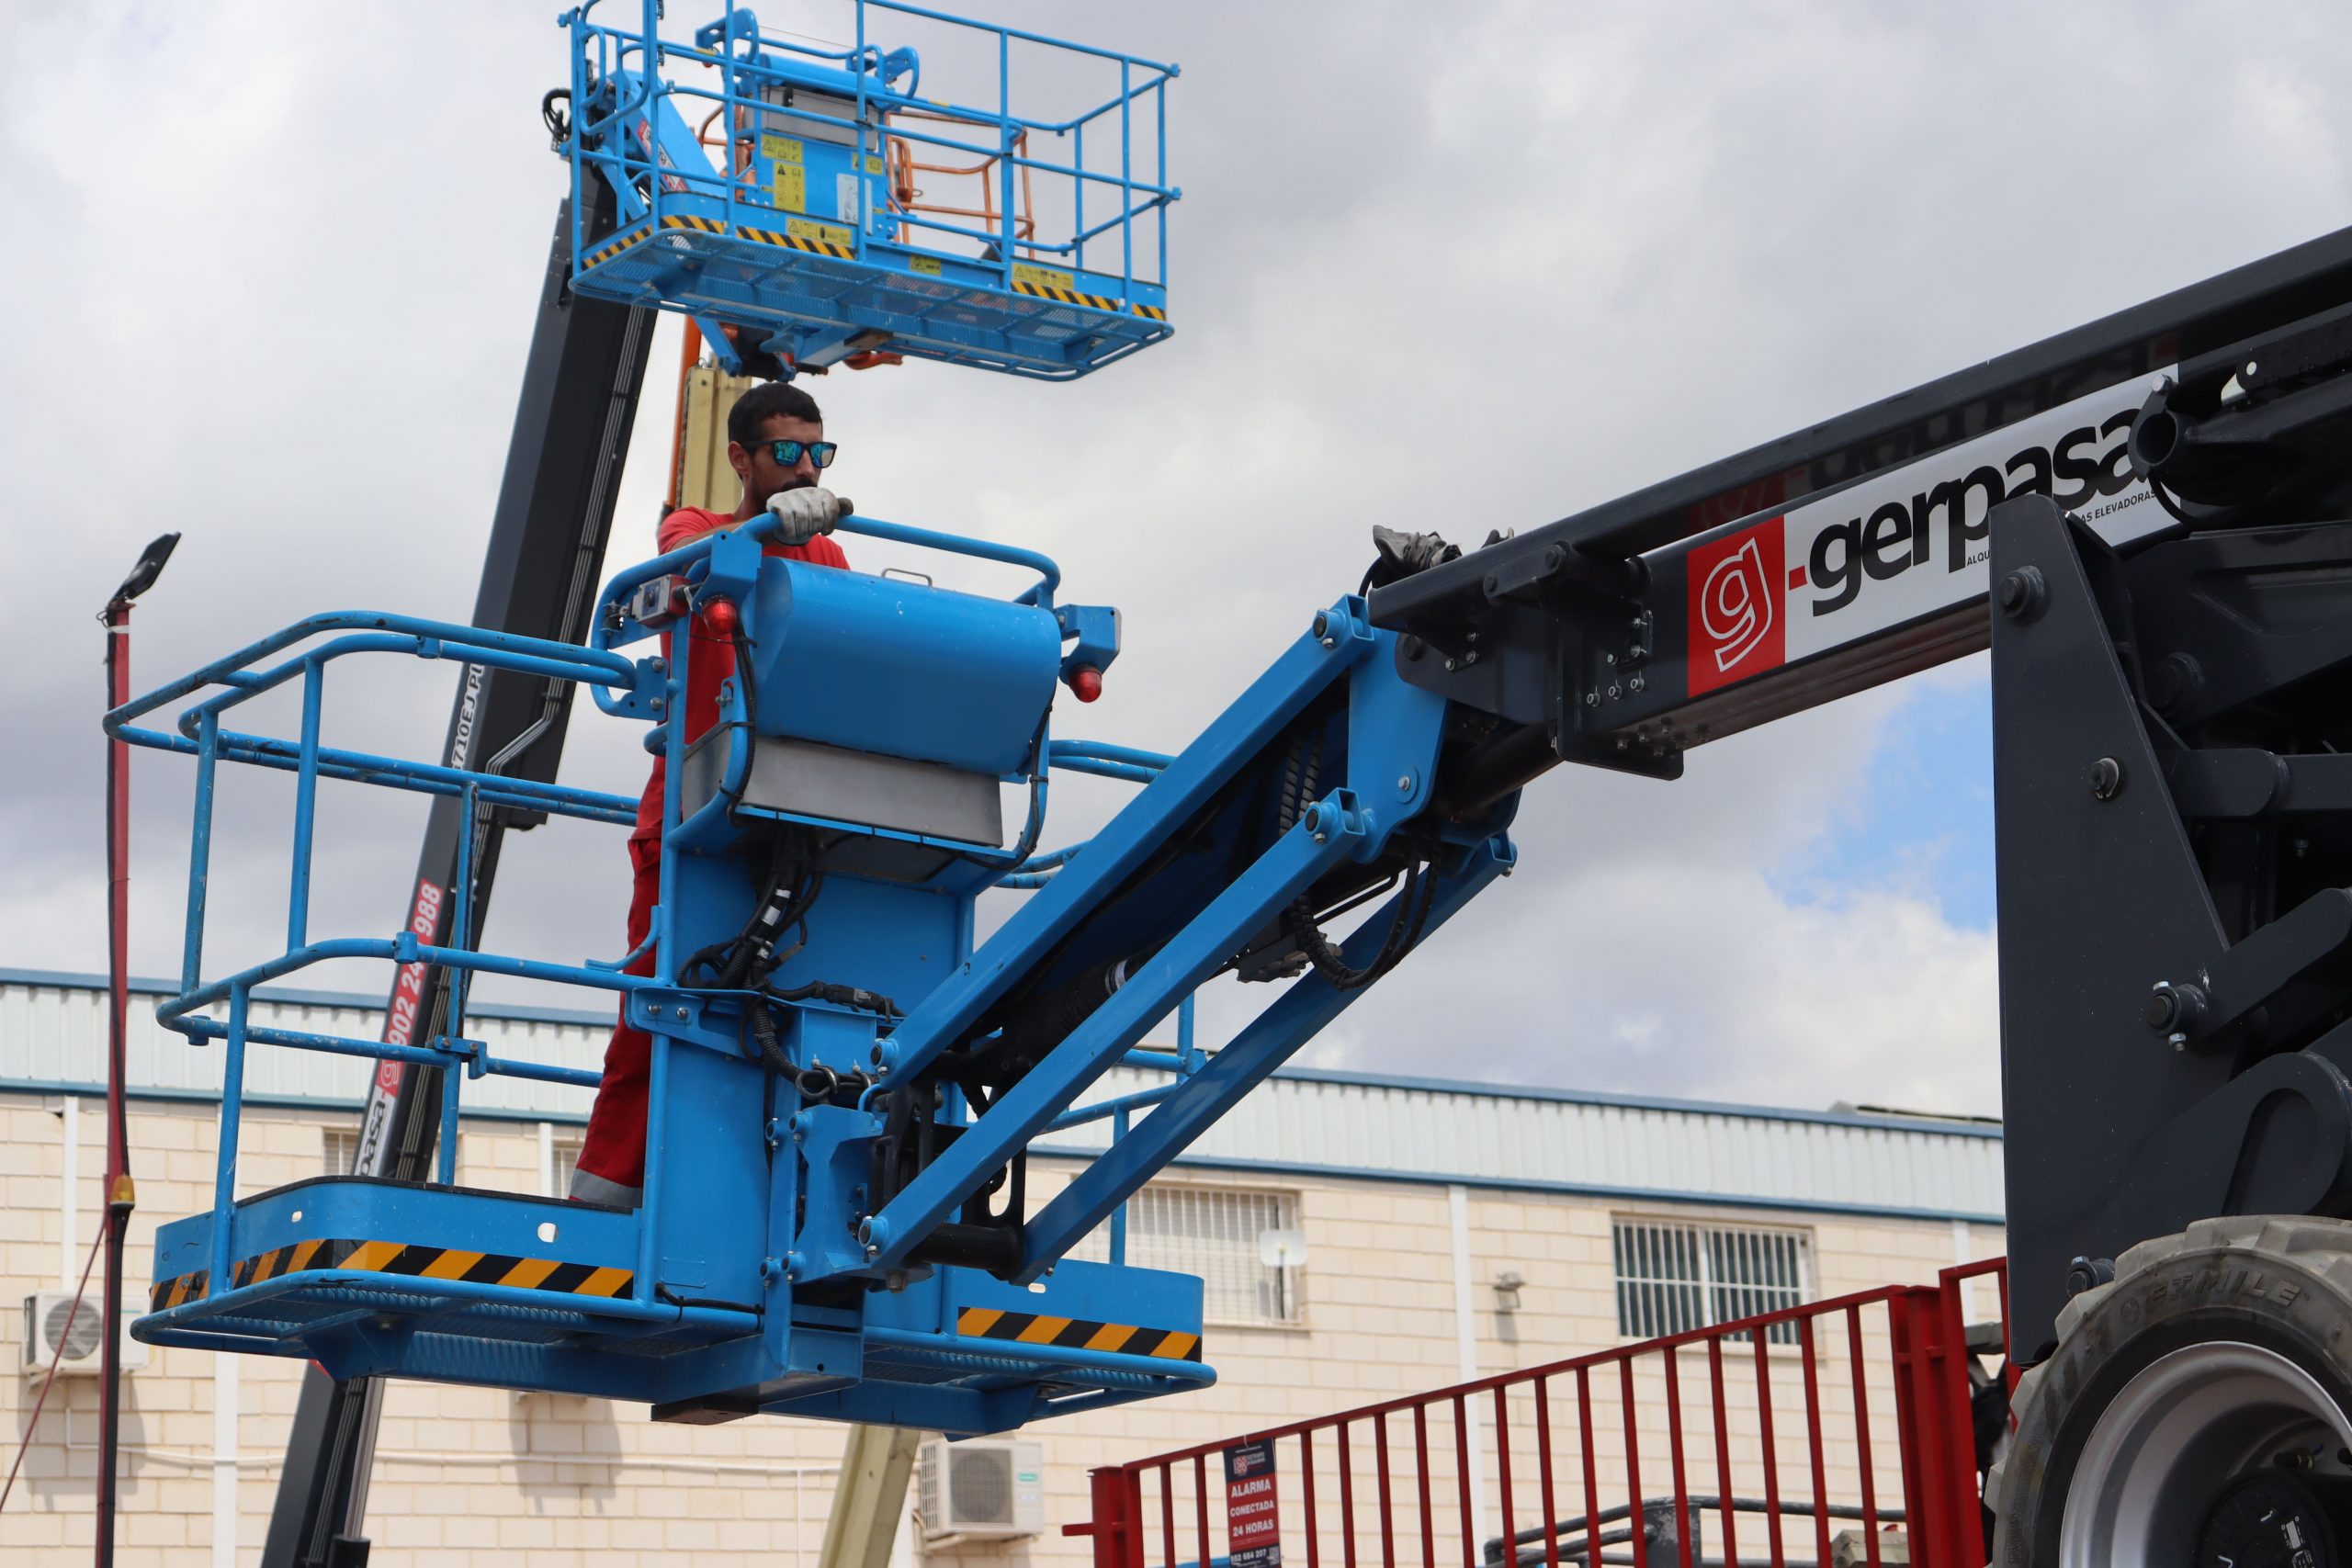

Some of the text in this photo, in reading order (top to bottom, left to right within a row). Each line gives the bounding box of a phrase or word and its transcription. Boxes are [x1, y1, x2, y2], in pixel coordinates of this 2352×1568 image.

[2095, 490, 2156, 520] ELEVADORAS
[450, 693, 476, 769] 710EJ
[360, 1100, 386, 1176] pasa
[389, 997, 415, 1046] 902
[414, 883, 440, 937] 988
[1231, 1478, 1272, 1498] ALARMA
[1229, 1499, 1274, 1517] CONECTADA
[1232, 1518, 1273, 1538] 24 HORAS
